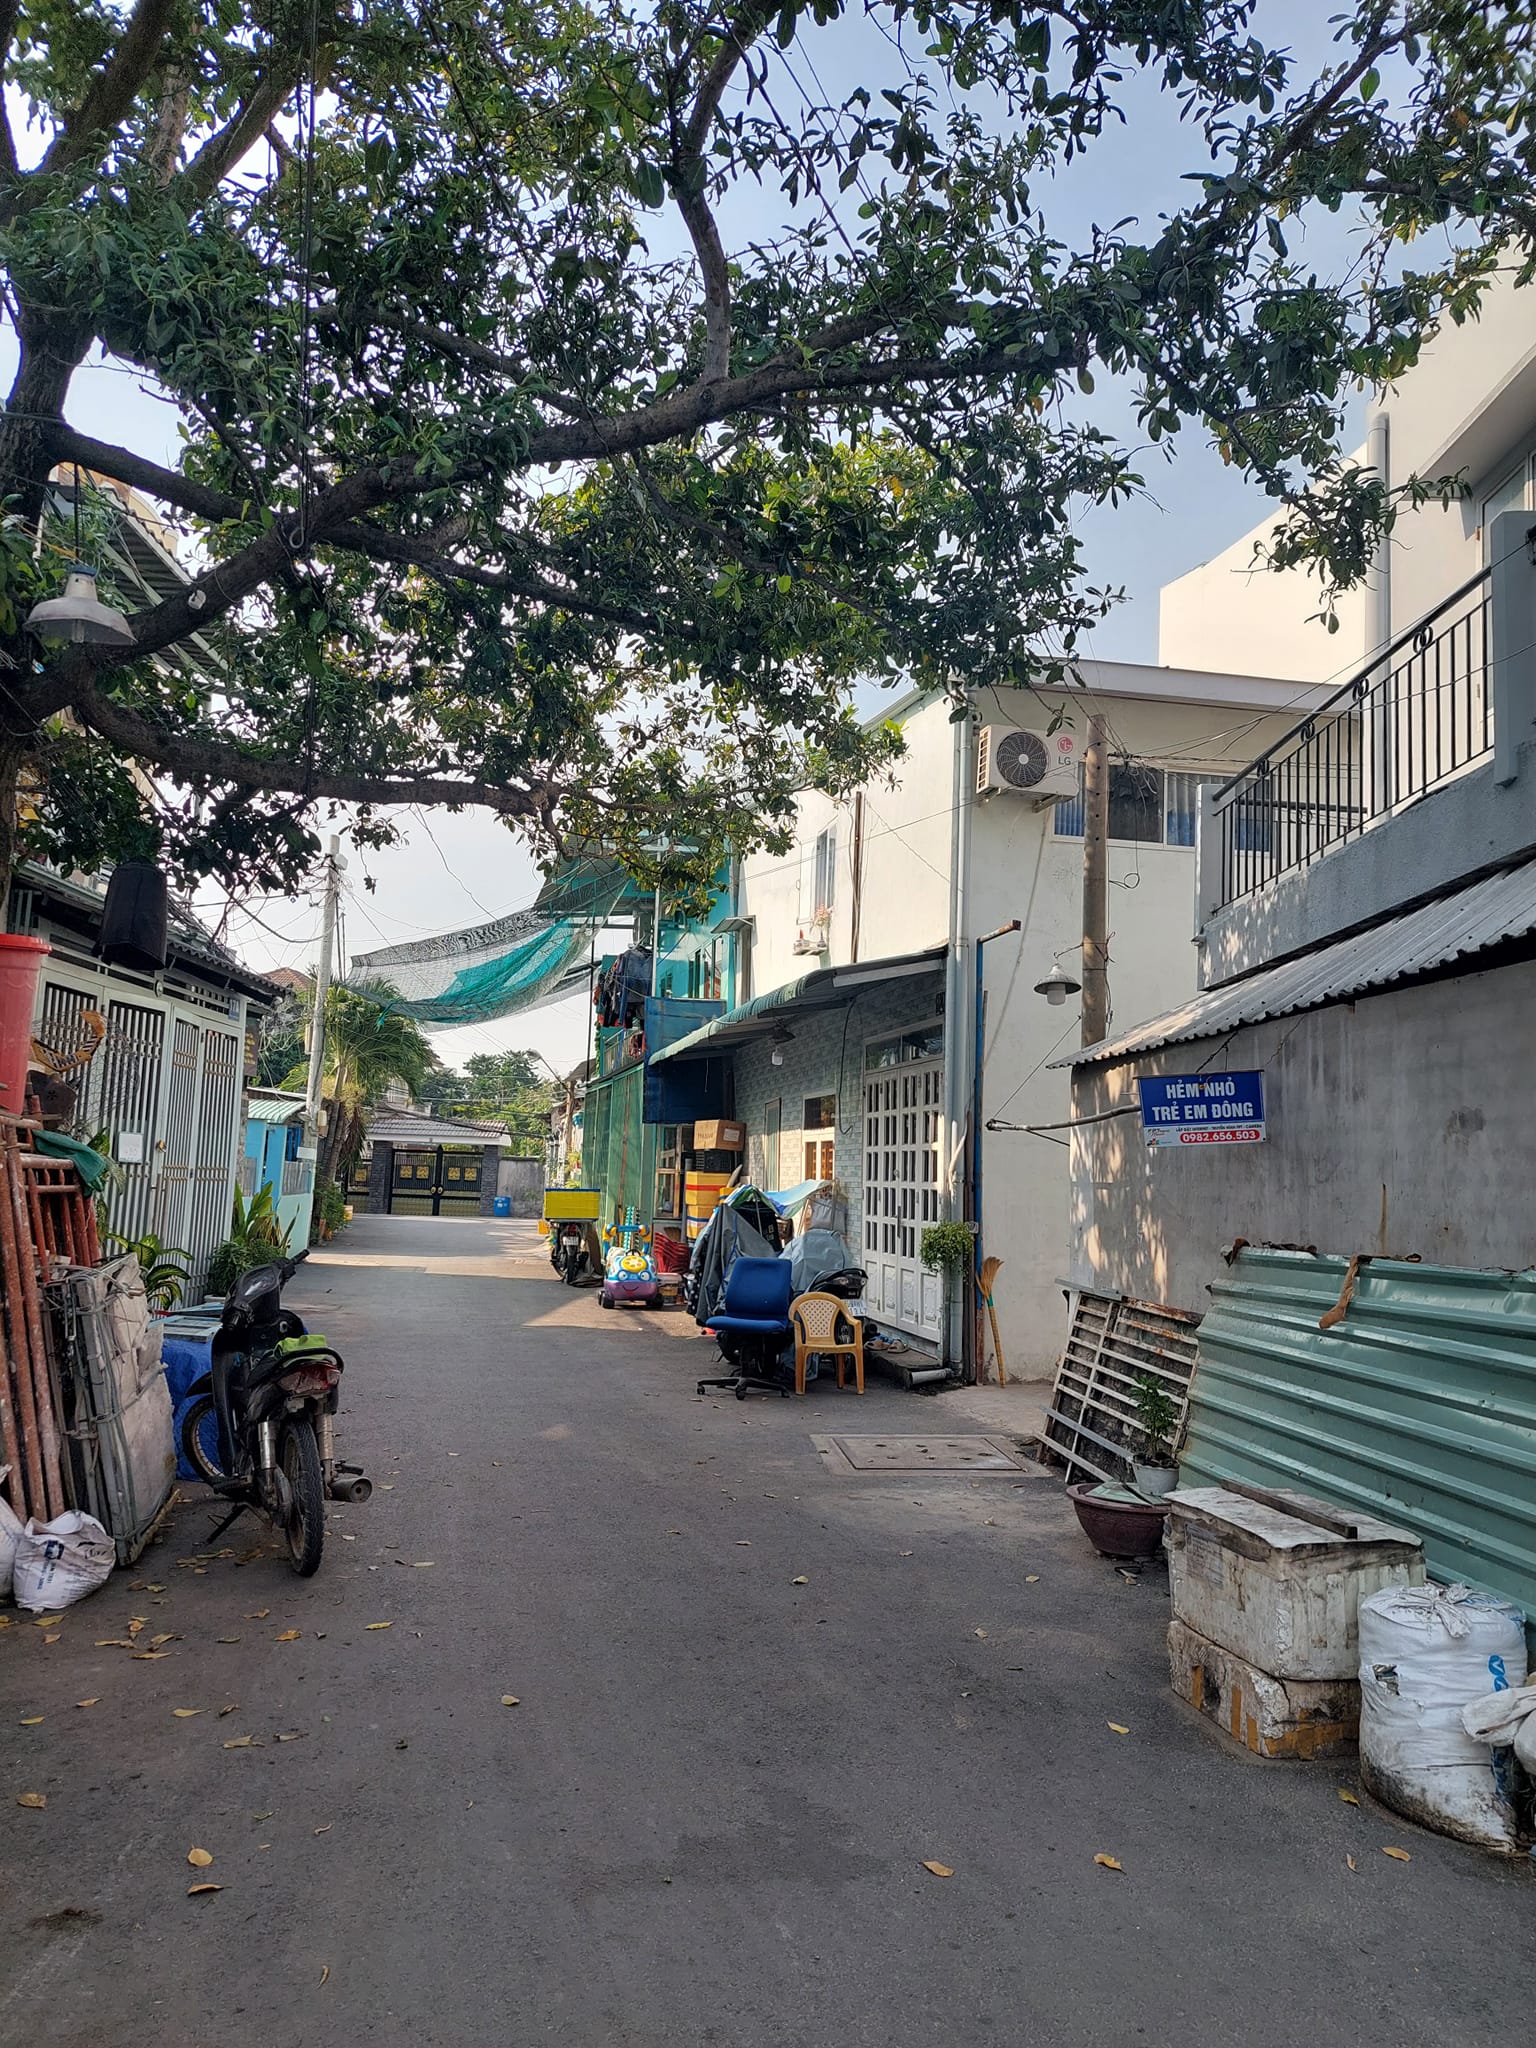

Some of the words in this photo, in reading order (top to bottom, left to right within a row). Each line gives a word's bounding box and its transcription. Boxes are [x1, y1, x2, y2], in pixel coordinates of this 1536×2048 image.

[1058, 755, 1072, 766] LG
[1166, 1079, 1200, 1099] HẺM
[1204, 1077, 1236, 1097] NHỎ
[1152, 1101, 1180, 1121] TRẺ
[1184, 1104, 1208, 1119] EM
[1211, 1101, 1254, 1118] ĐÔNG
[1182, 1131, 1256, 1143] 0982.656.503
